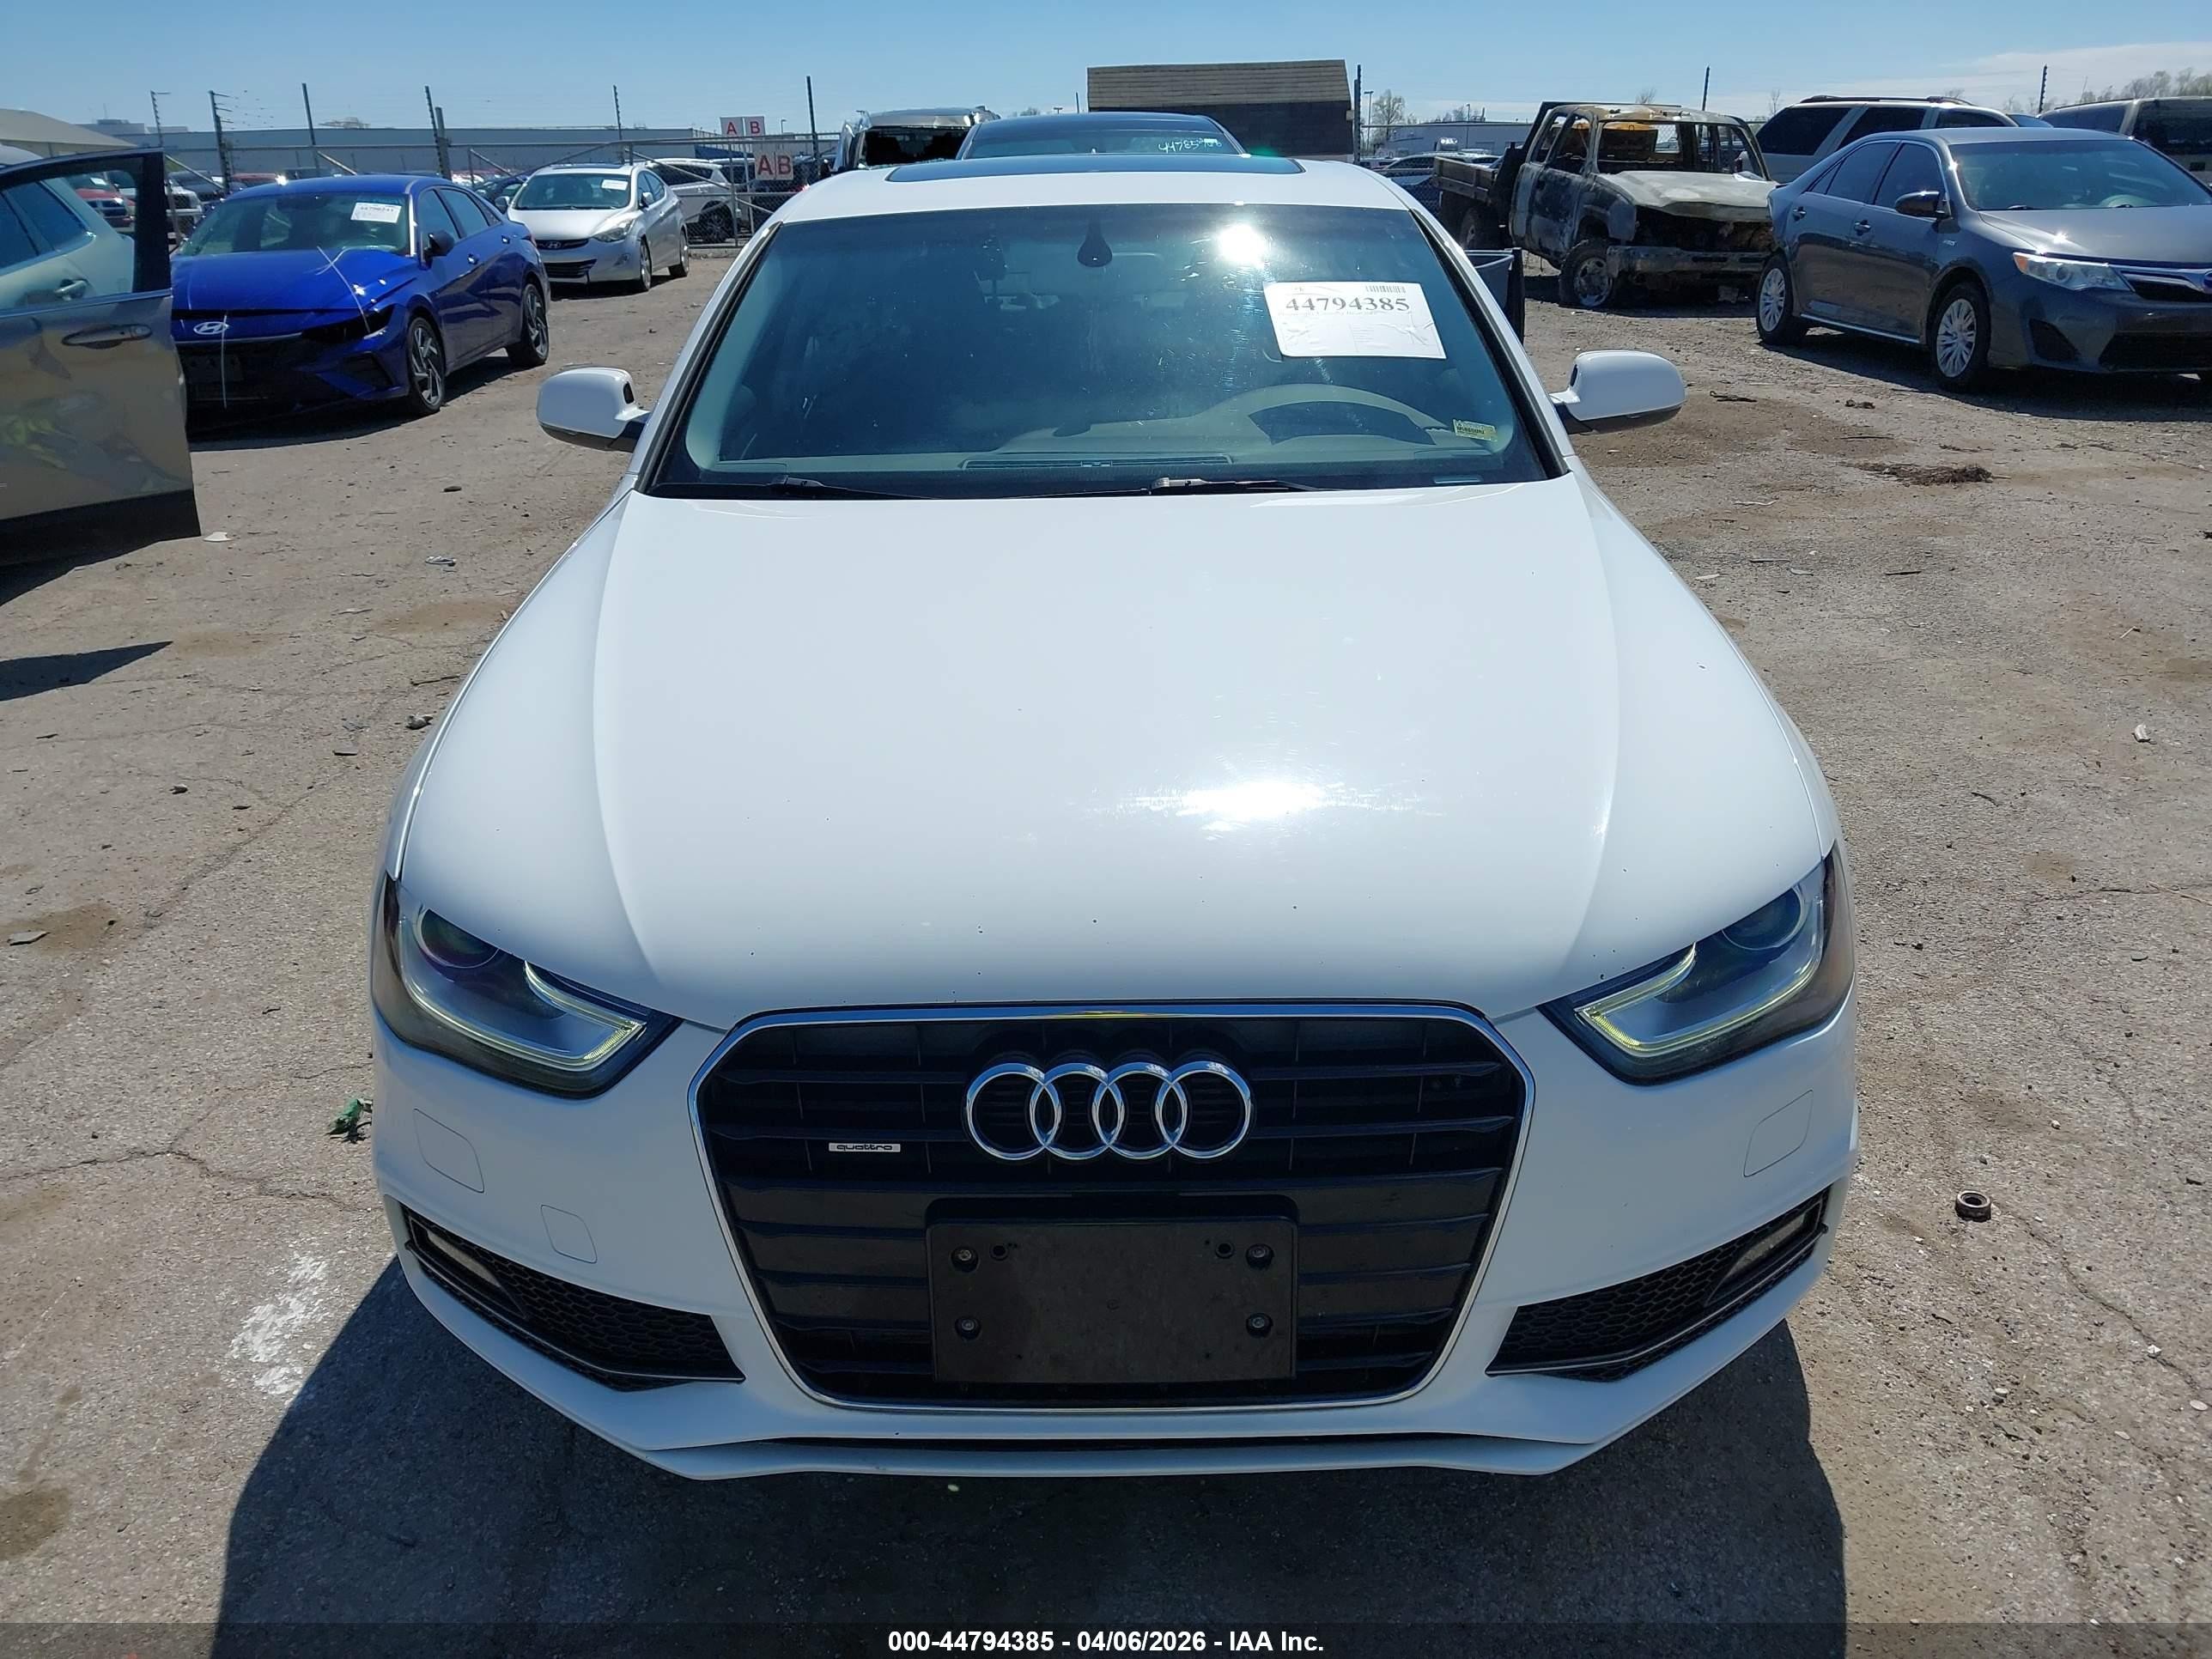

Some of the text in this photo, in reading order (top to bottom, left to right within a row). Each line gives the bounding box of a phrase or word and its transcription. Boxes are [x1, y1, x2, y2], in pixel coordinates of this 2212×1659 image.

[726, 121, 761, 135] A B
[757, 155, 792, 176] A B
[1285, 296, 1410, 312] 44794385
